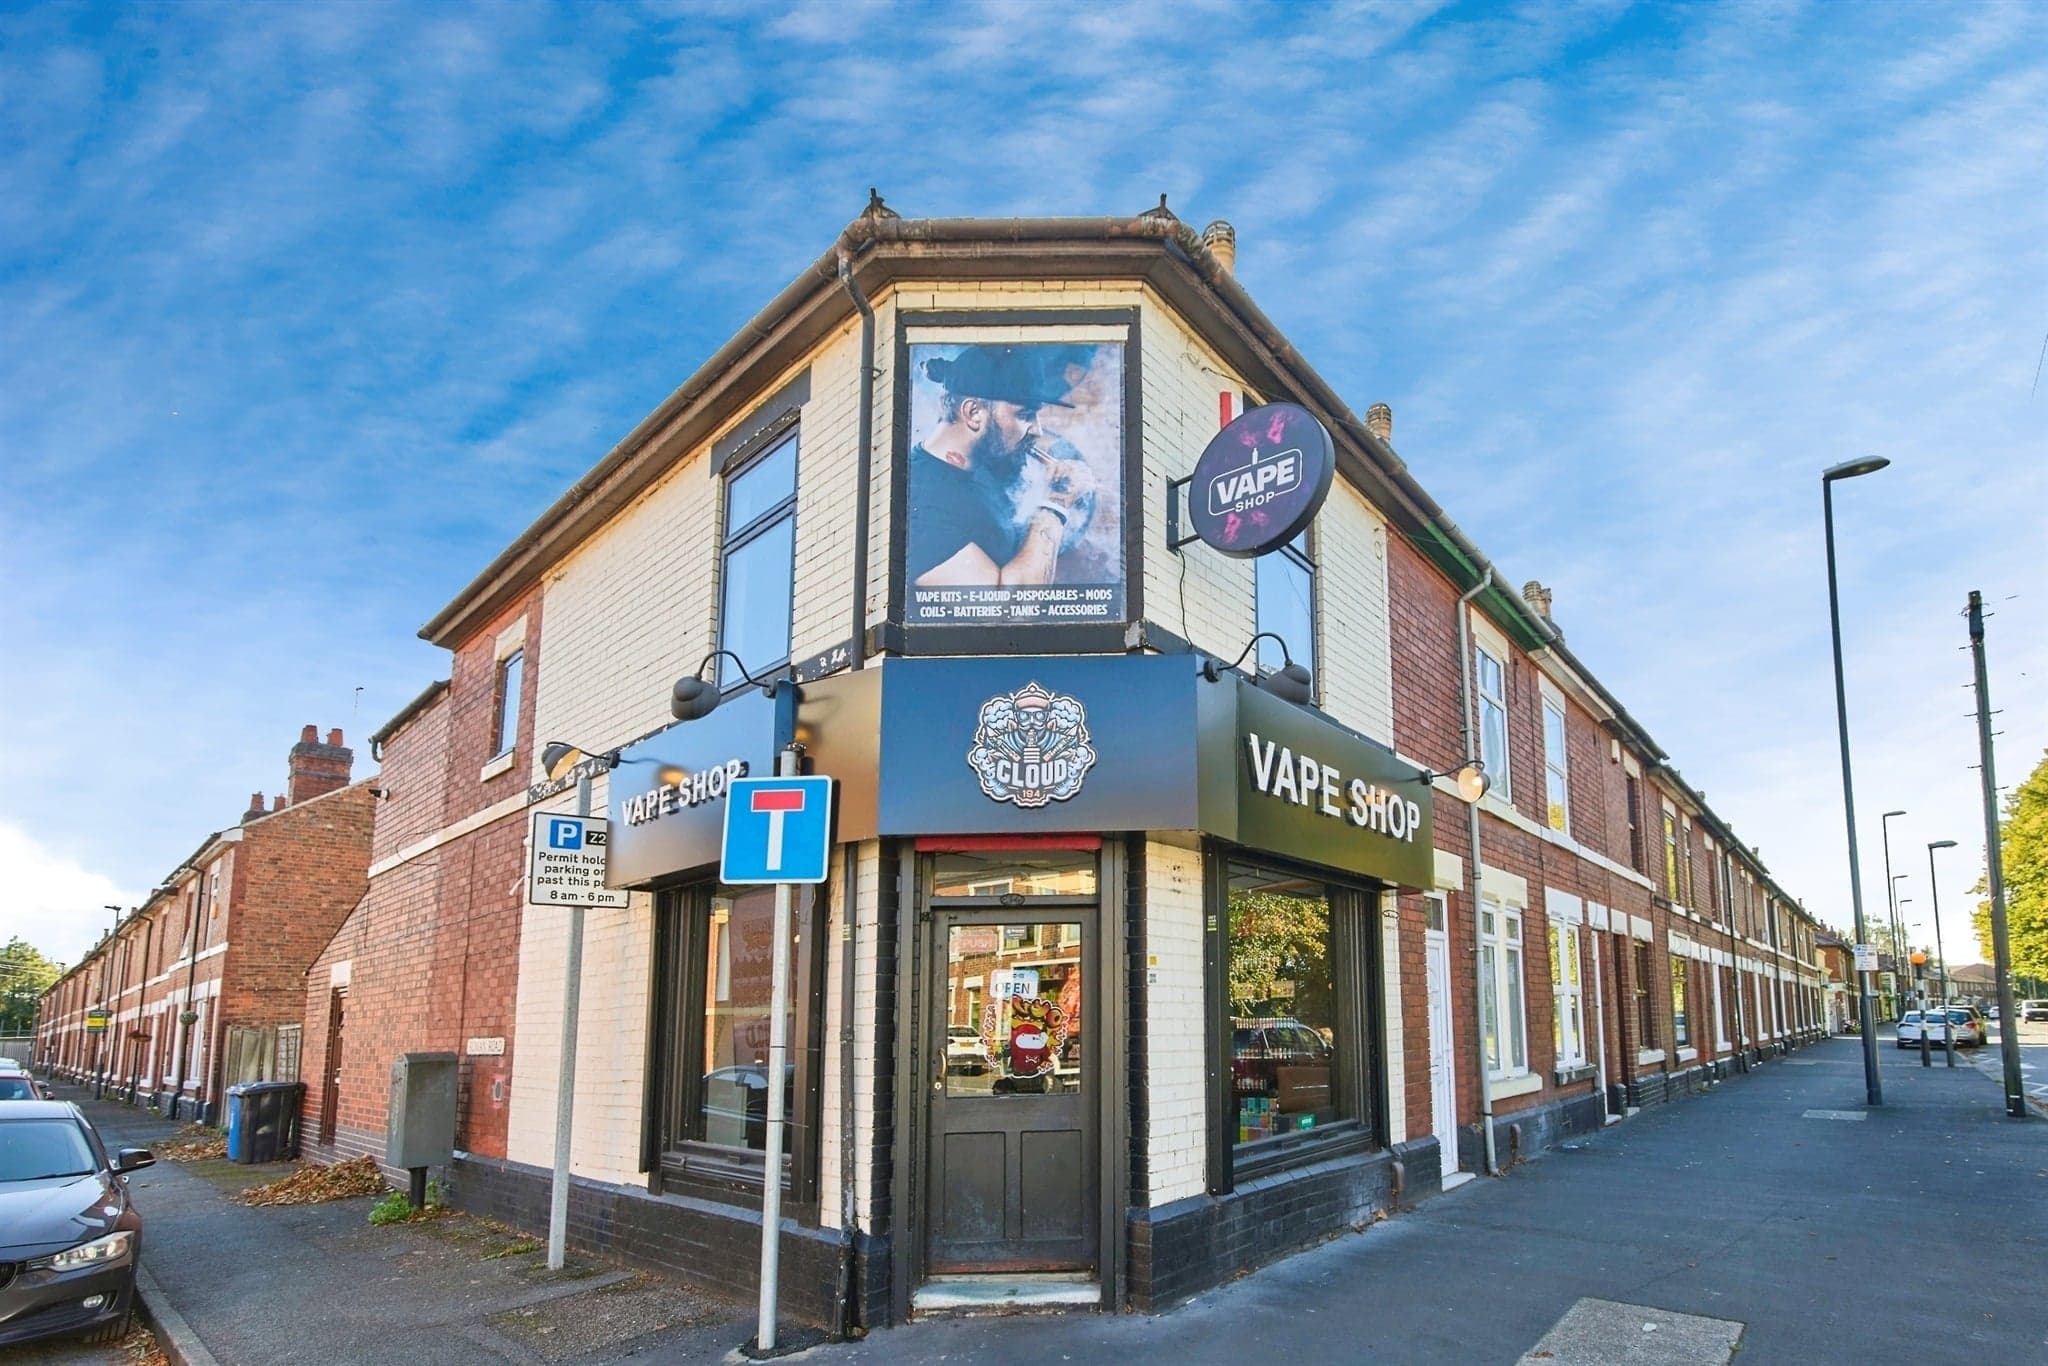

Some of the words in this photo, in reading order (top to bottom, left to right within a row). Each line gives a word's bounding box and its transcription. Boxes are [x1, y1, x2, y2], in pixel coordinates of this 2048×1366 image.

[1216, 456, 1296, 505] VAPE
[1233, 491, 1275, 513] SHOP
[915, 591, 940, 603] VAPE
[940, 591, 962, 603] KITS
[969, 590, 1011, 603] E-LIQUID
[1085, 589, 1113, 601] MODS
[920, 605, 946, 618] COILS
[953, 605, 1003, 617] BATTERIES
[1010, 604, 1041, 617] TANKS
[1047, 603, 1108, 616] ACCESSORIES
[996, 758, 1069, 789] CLOUD
[621, 784, 673, 827] VAPE
[678, 758, 741, 808] SHOP
[1250, 732, 1341, 818] VAPE
[1351, 778, 1420, 843] SHOP
[557, 823, 578, 846] P
[539, 851, 578, 864] Permit
[544, 864, 590, 877] parking
[537, 876, 564, 886] past
[568, 876, 590, 887] this
[550, 890, 558, 900] 8
[588, 892, 595, 901] 6
[598, 894, 615, 903] pm
